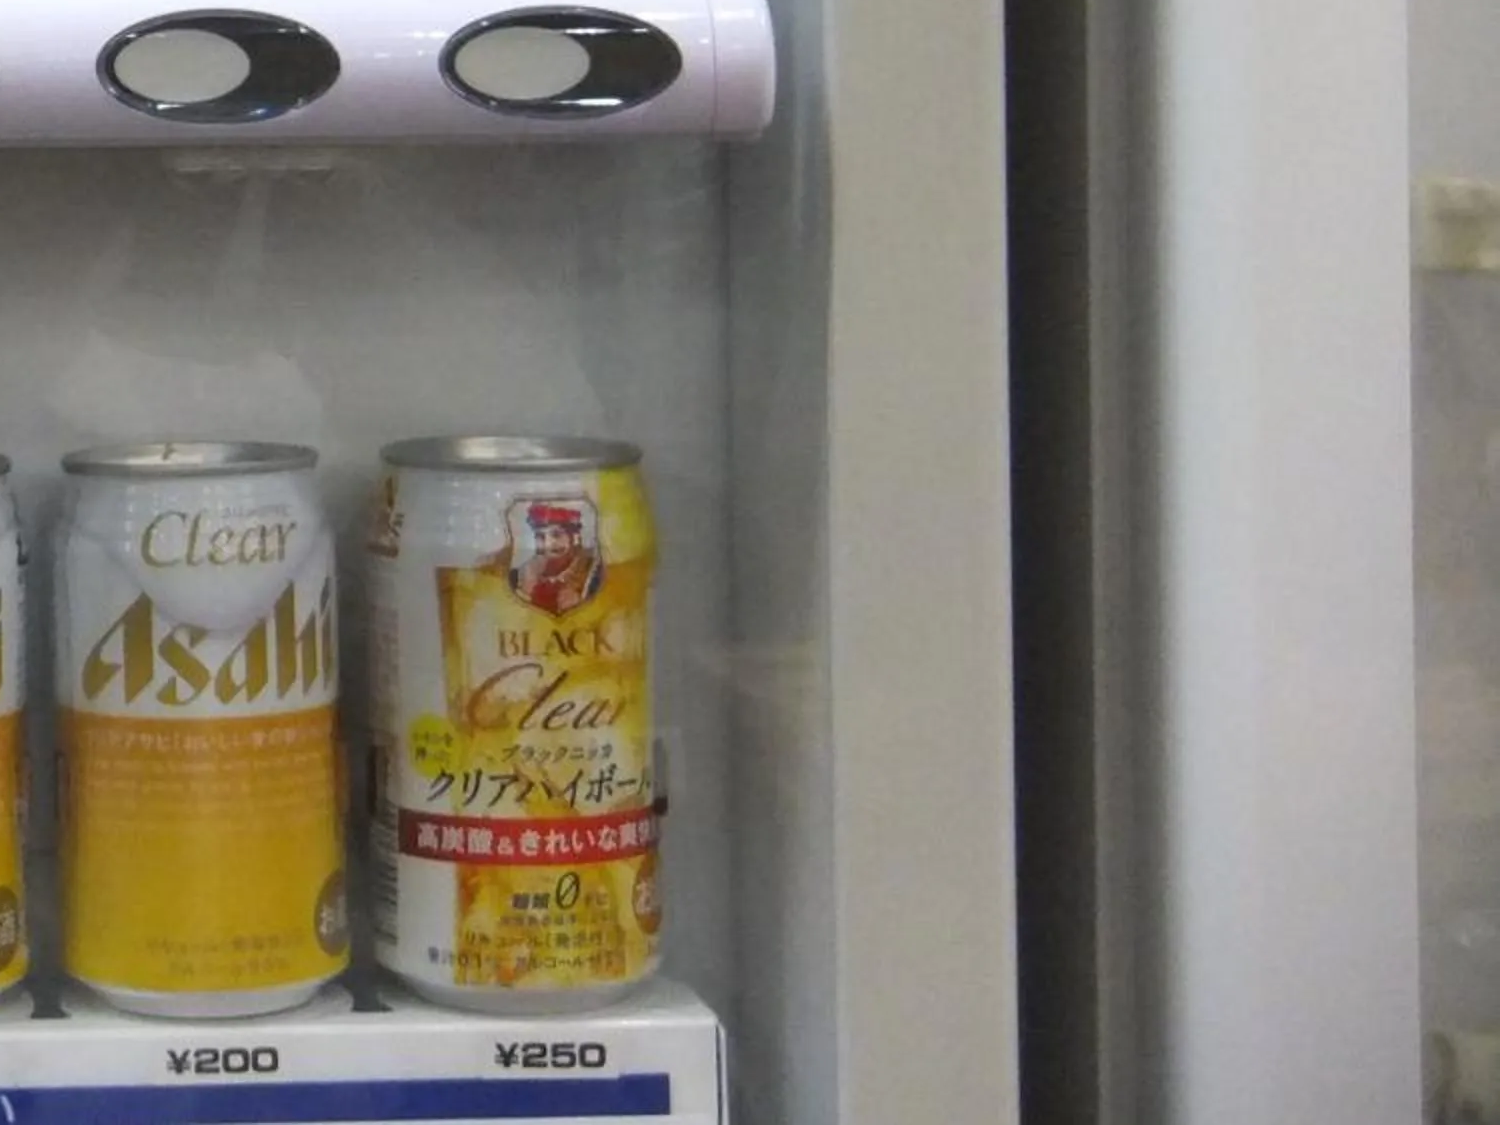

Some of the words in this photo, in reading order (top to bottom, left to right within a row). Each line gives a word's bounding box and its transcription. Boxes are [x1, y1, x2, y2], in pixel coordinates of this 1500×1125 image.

[140, 509, 298, 569] Clear
[81, 575, 333, 707] Asahi
[167, 1047, 279, 1074] ¥200
[494, 1042, 607, 1069] ¥250
